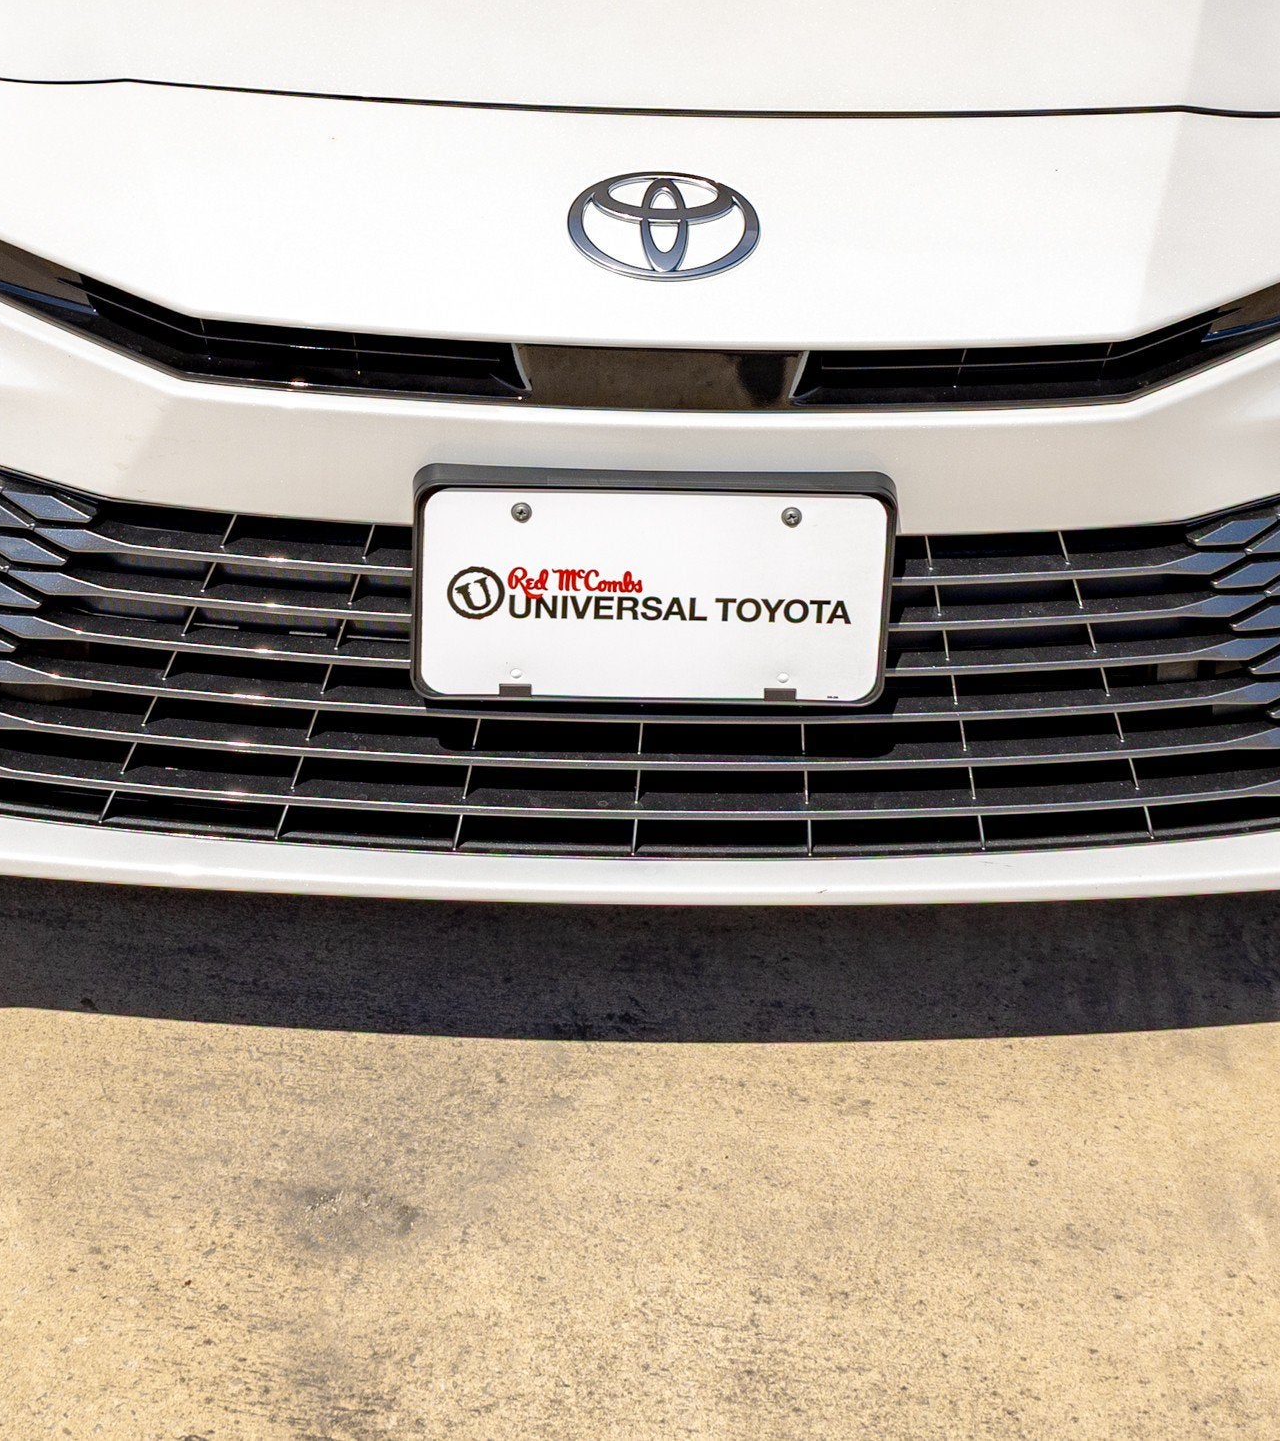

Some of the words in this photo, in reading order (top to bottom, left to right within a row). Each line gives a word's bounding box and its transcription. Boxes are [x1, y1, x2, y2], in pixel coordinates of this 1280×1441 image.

[507, 566, 549, 599] Red
[552, 568, 643, 593] McCombs
[508, 594, 707, 622] UNIVERSAL
[715, 597, 852, 625] TOYOTA
